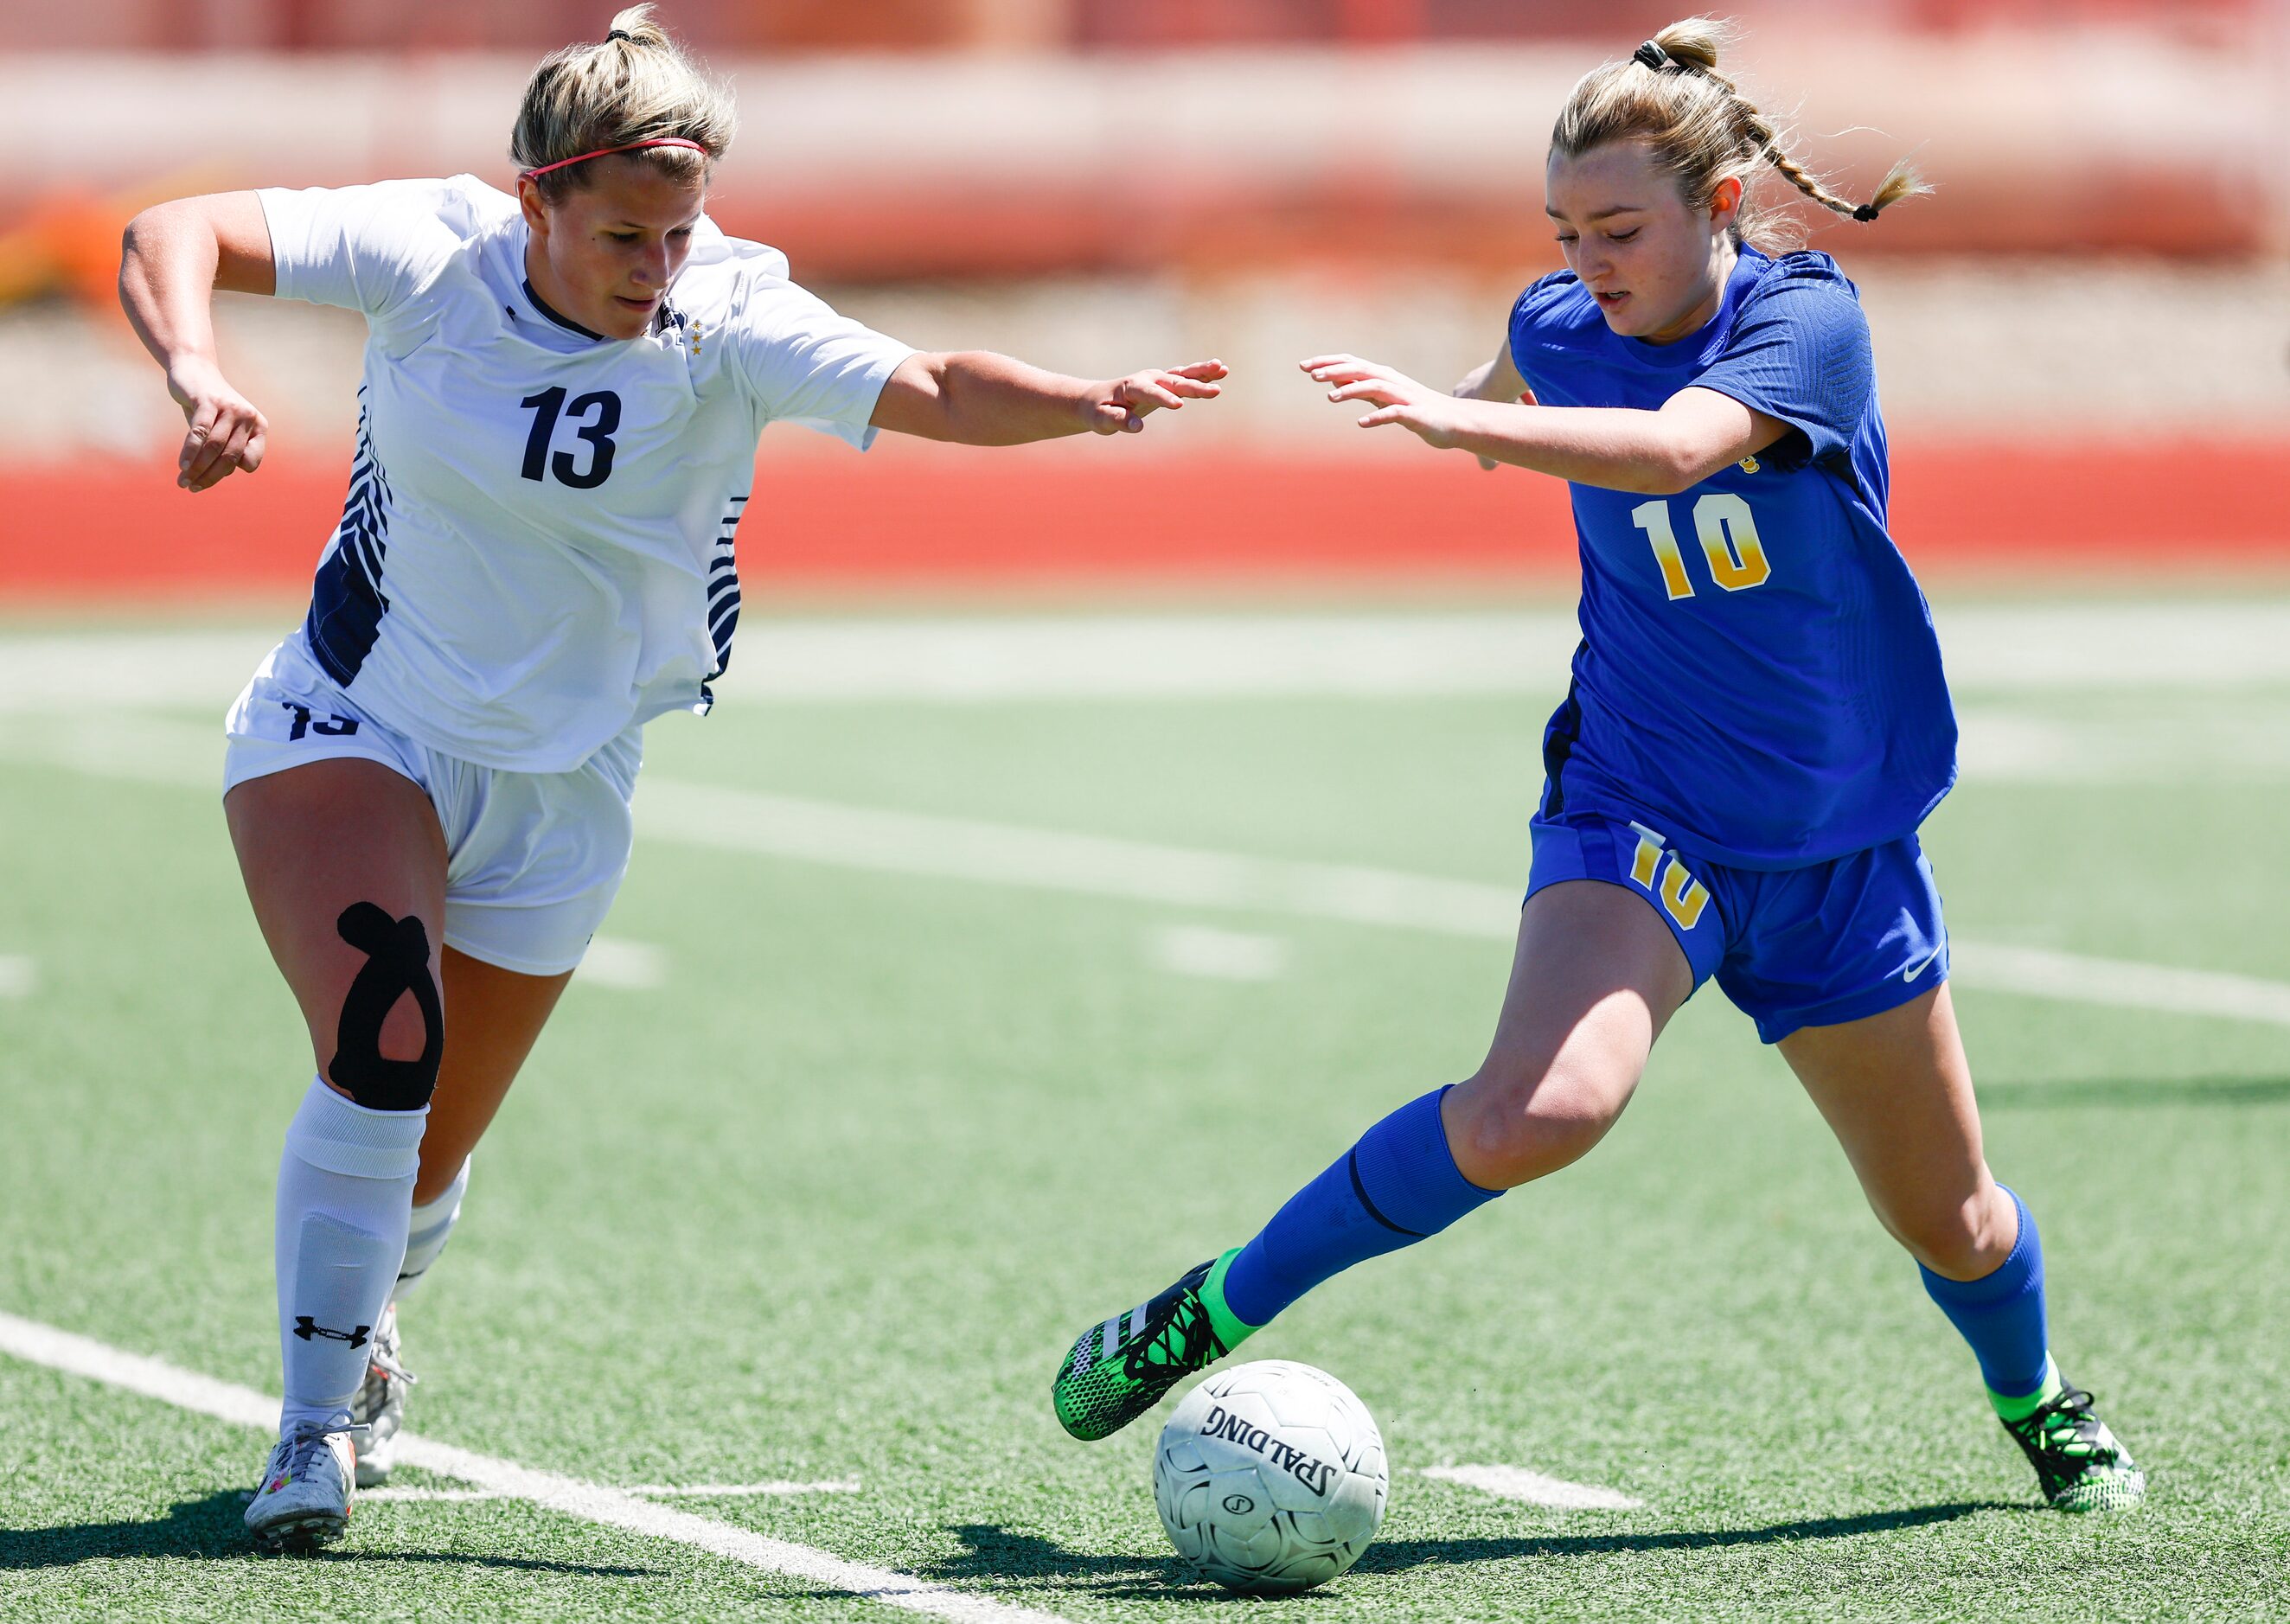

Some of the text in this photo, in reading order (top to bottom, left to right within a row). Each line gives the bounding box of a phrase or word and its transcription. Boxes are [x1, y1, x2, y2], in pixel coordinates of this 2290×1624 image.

[520, 386, 622, 489] 13
[1631, 493, 1772, 601] 10
[1628, 820, 1711, 931] 10
[1200, 1406, 1337, 1497] SPALDING
